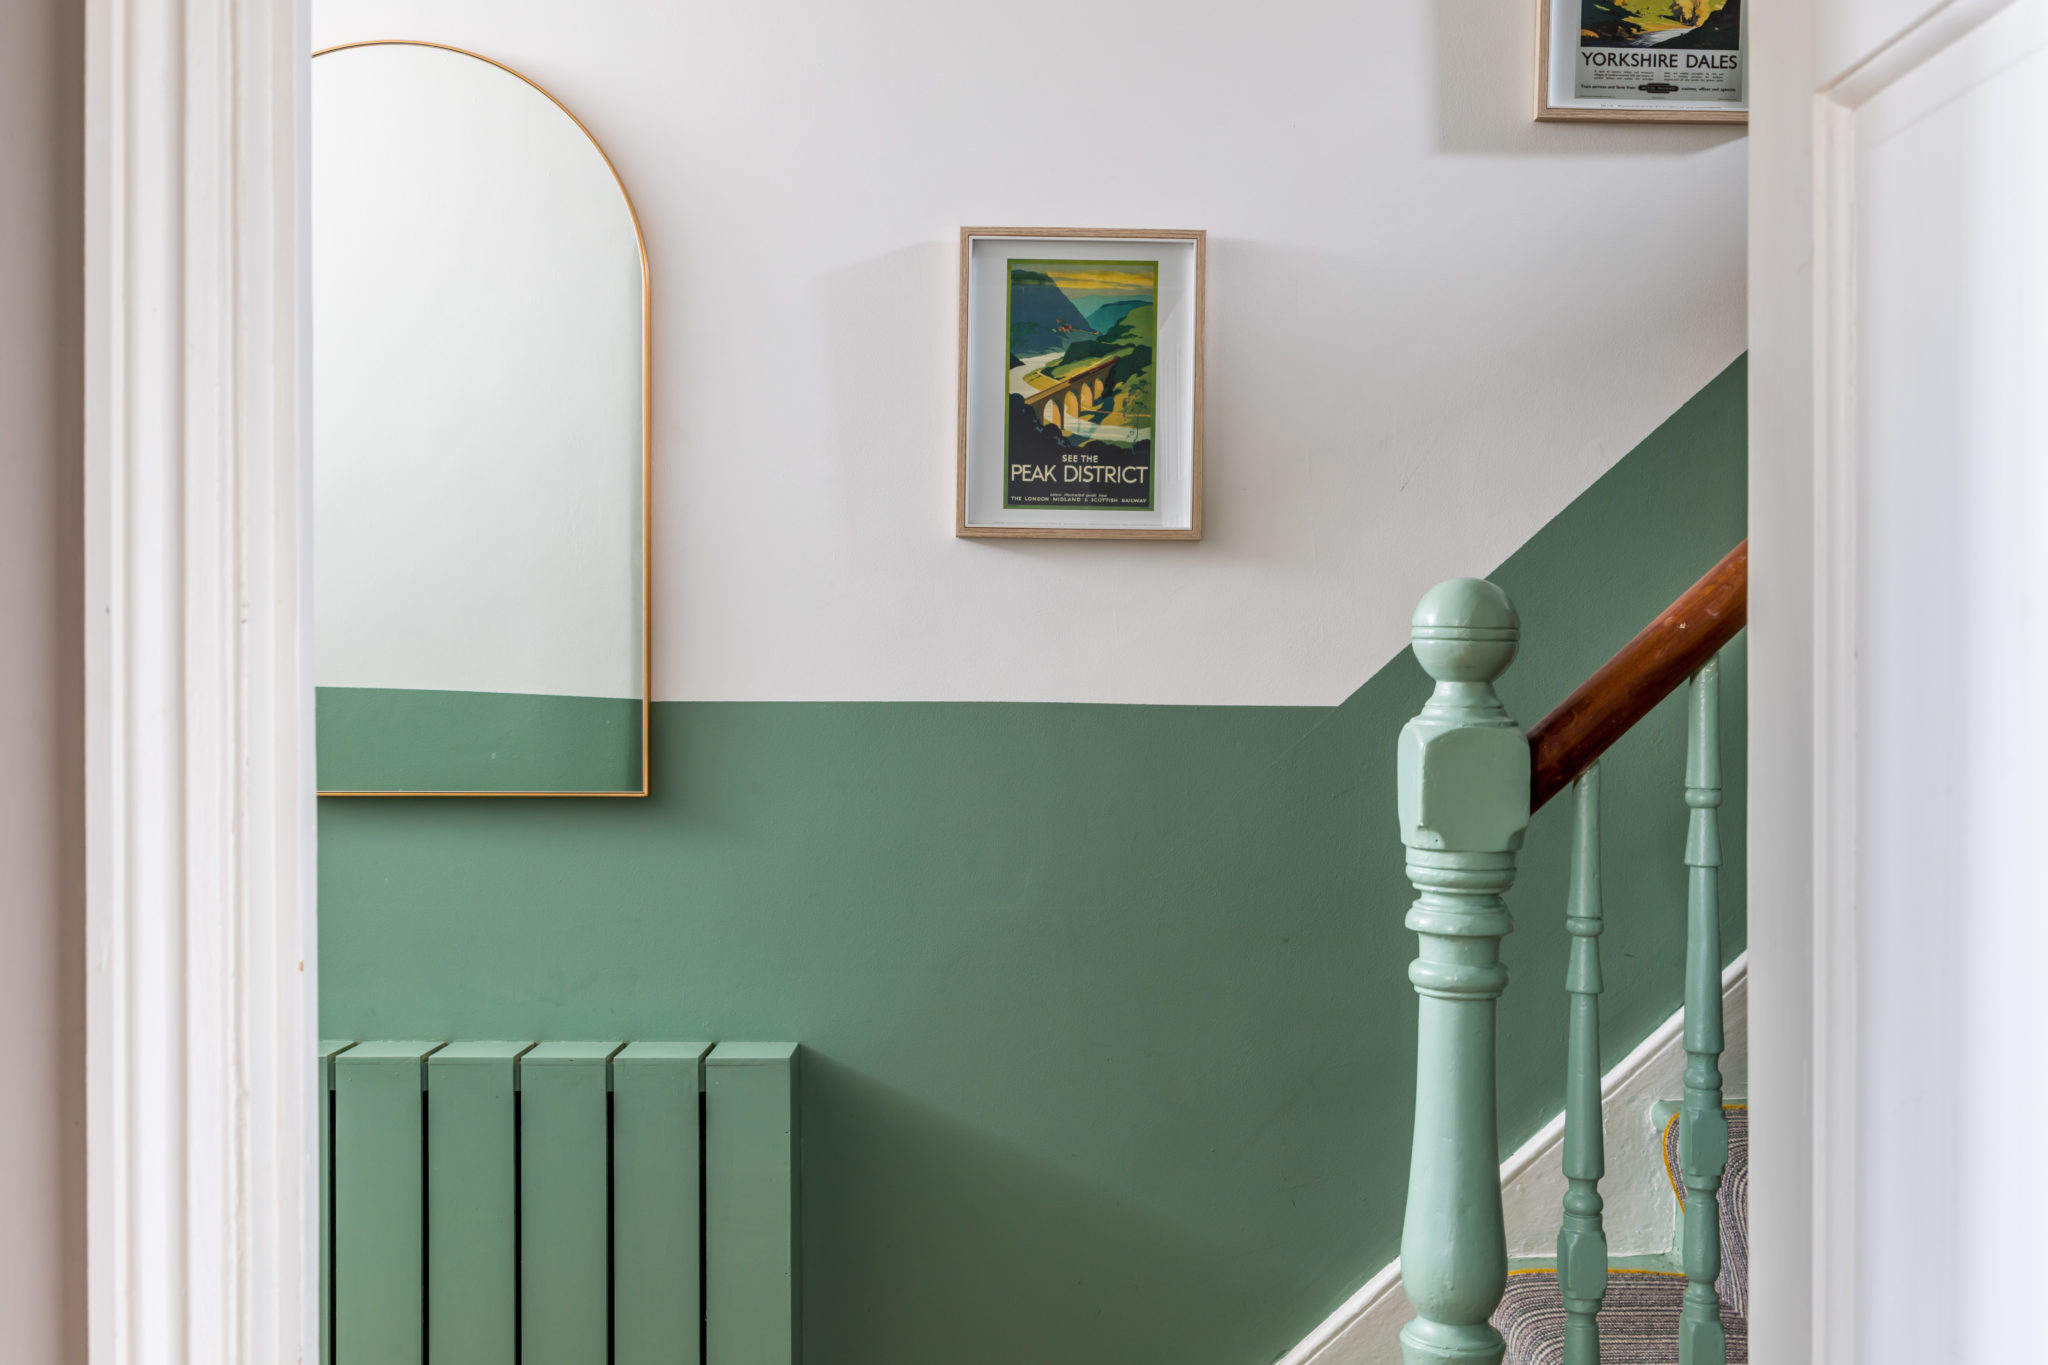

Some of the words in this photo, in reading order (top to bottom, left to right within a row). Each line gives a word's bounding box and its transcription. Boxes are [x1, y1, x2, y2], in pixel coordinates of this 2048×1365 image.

[1581, 52, 1678, 68] YORKSHIRE
[1686, 54, 1738, 69] DALES
[1062, 454, 1078, 463] SEE
[1080, 455, 1098, 463] THE
[1011, 464, 1057, 482] PEAK
[1064, 465, 1149, 484] DISTRICT
